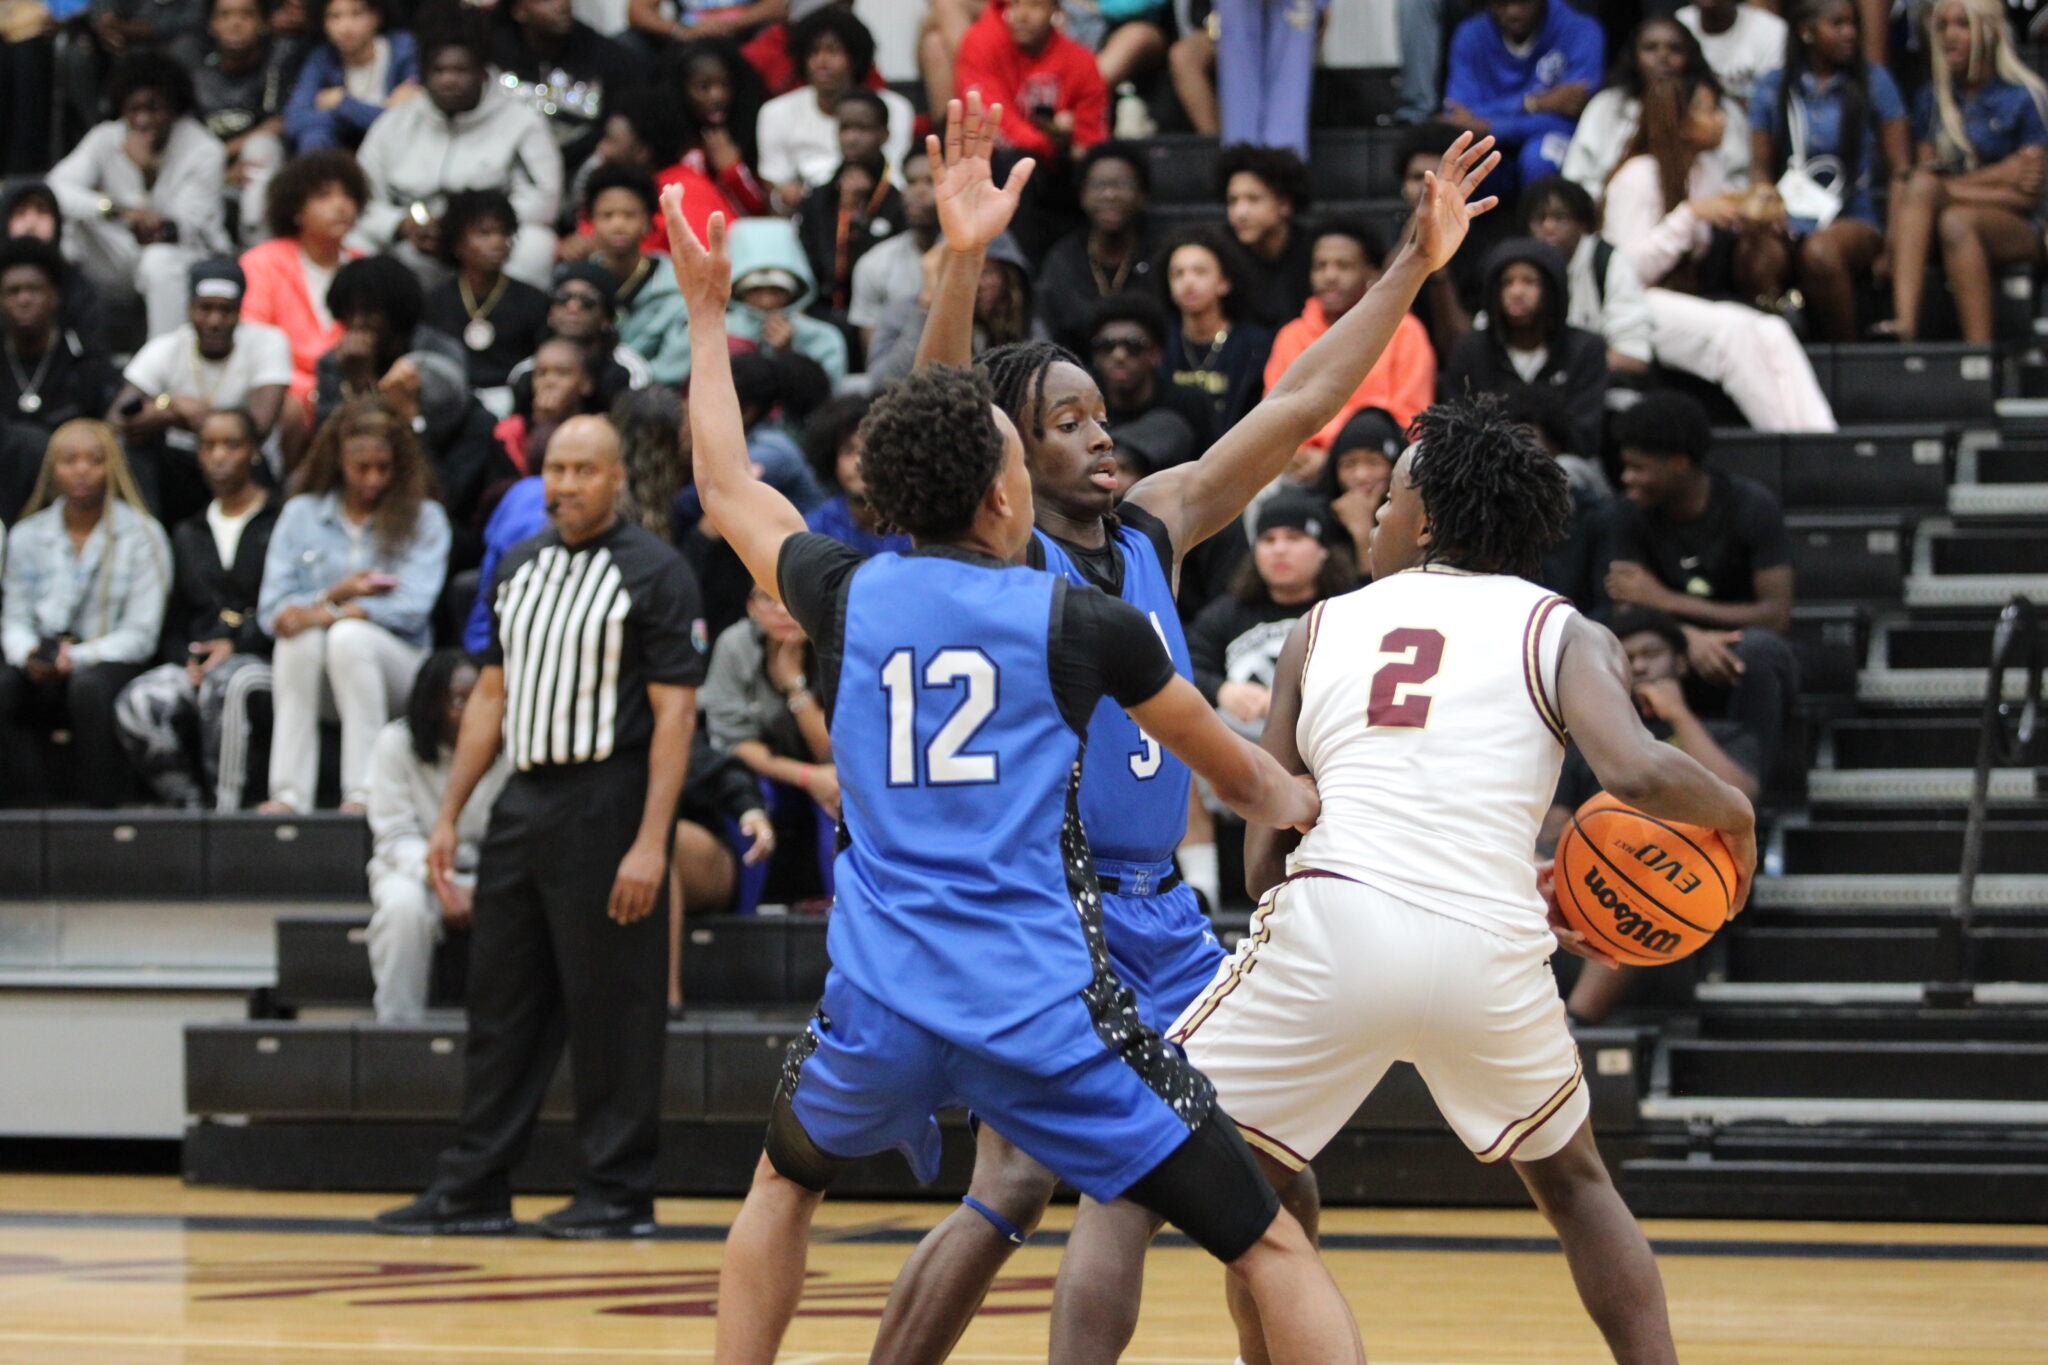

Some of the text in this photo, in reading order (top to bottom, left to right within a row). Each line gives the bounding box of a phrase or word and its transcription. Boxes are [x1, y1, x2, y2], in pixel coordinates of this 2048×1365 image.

[879, 646, 1000, 788] 12
[1366, 627, 1448, 731] 2
[1584, 865, 1682, 955] Wilson
